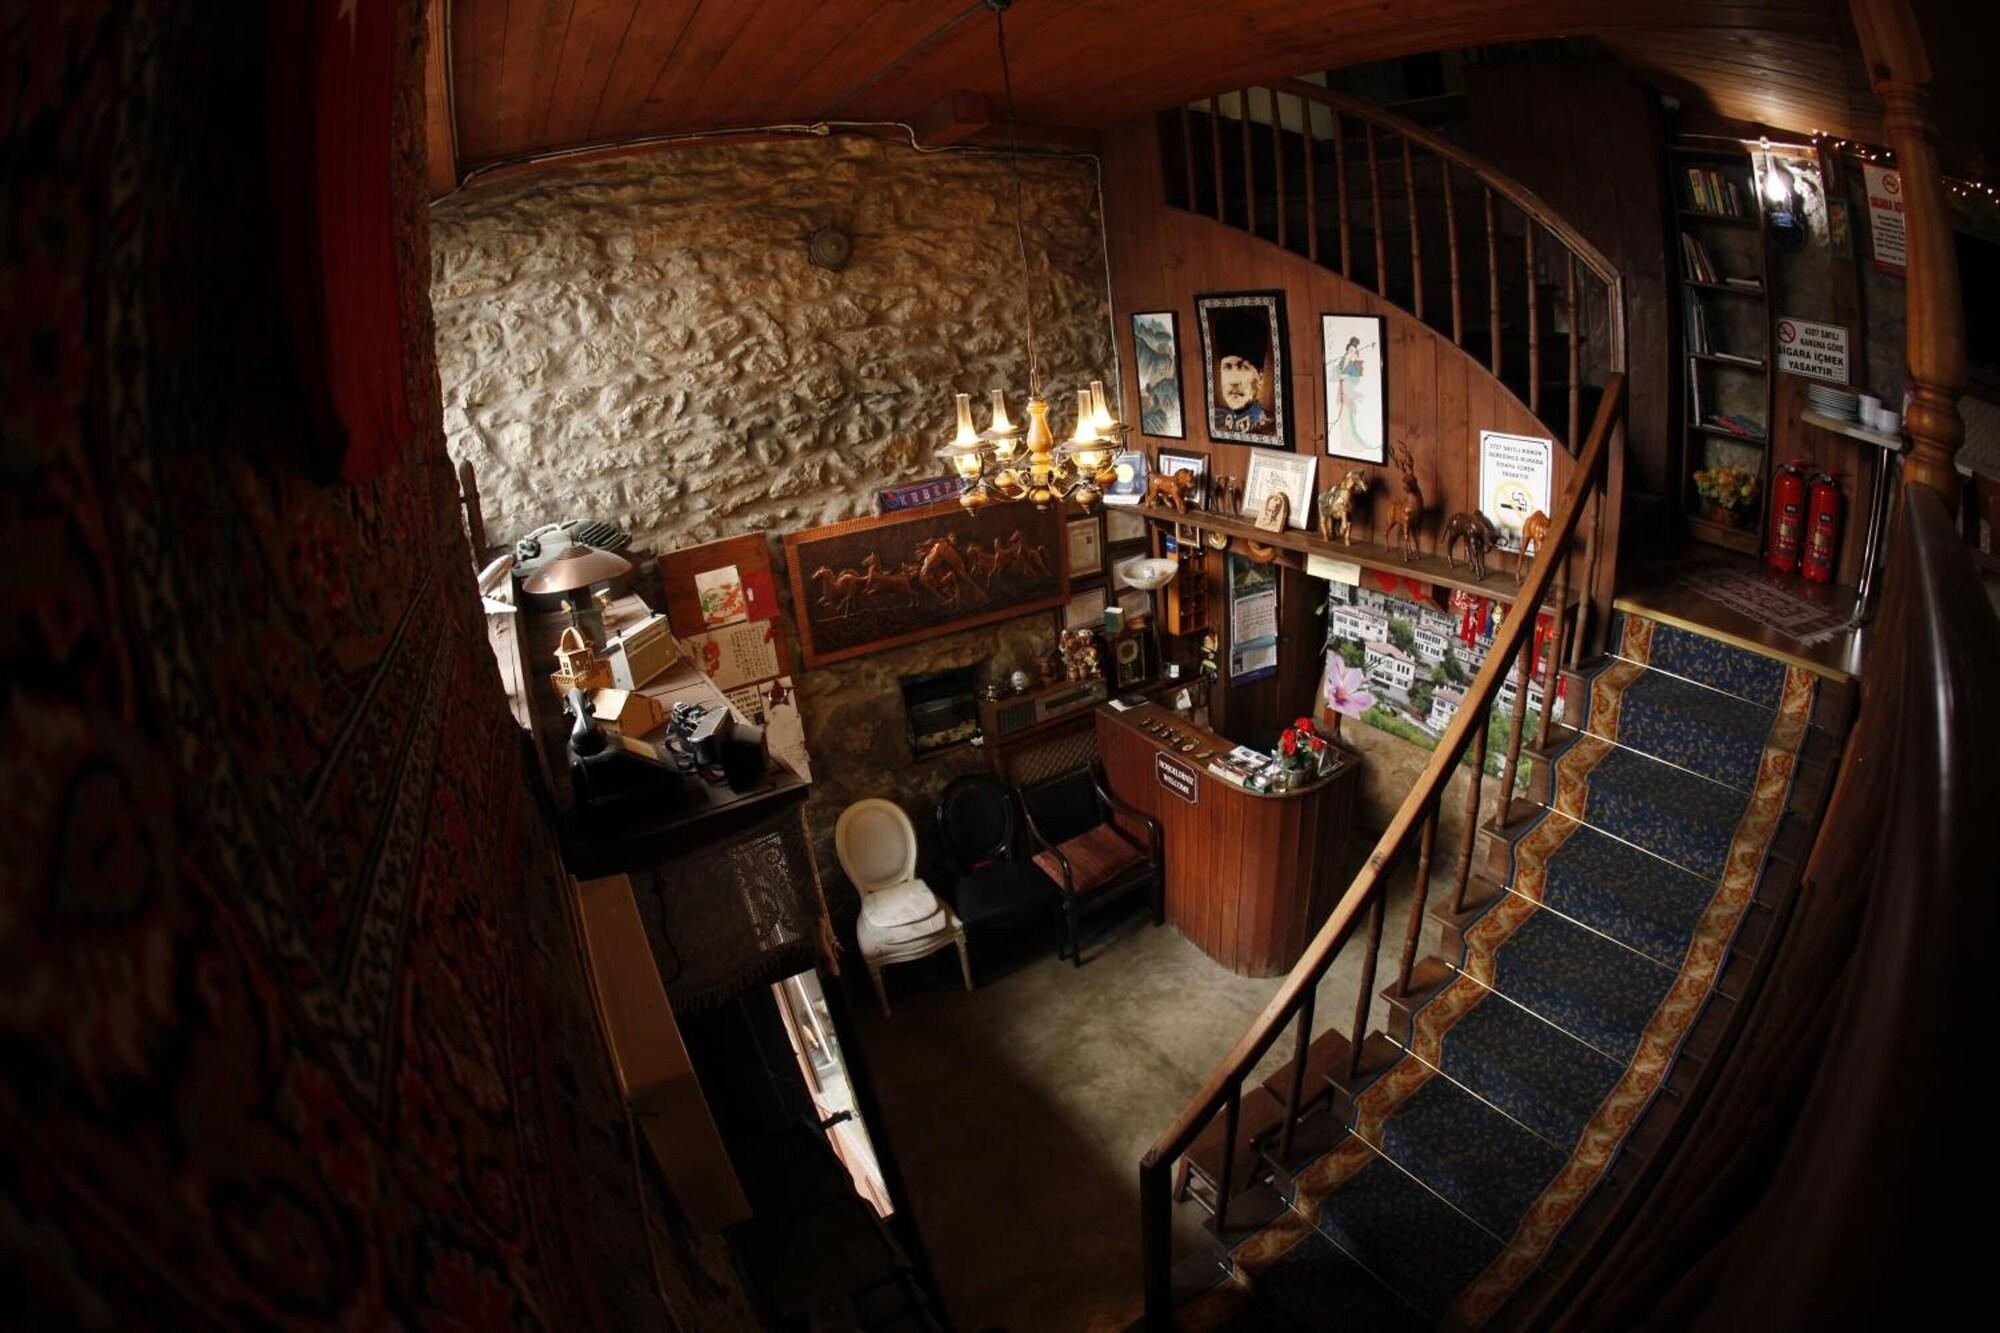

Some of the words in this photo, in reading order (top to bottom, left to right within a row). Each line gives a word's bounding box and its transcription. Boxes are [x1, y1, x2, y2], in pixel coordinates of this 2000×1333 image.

[1777, 344, 1812, 359] SİGARA
[1815, 351, 1843, 366] İÇMEK
[1789, 361, 1833, 377] YASAKTIR
